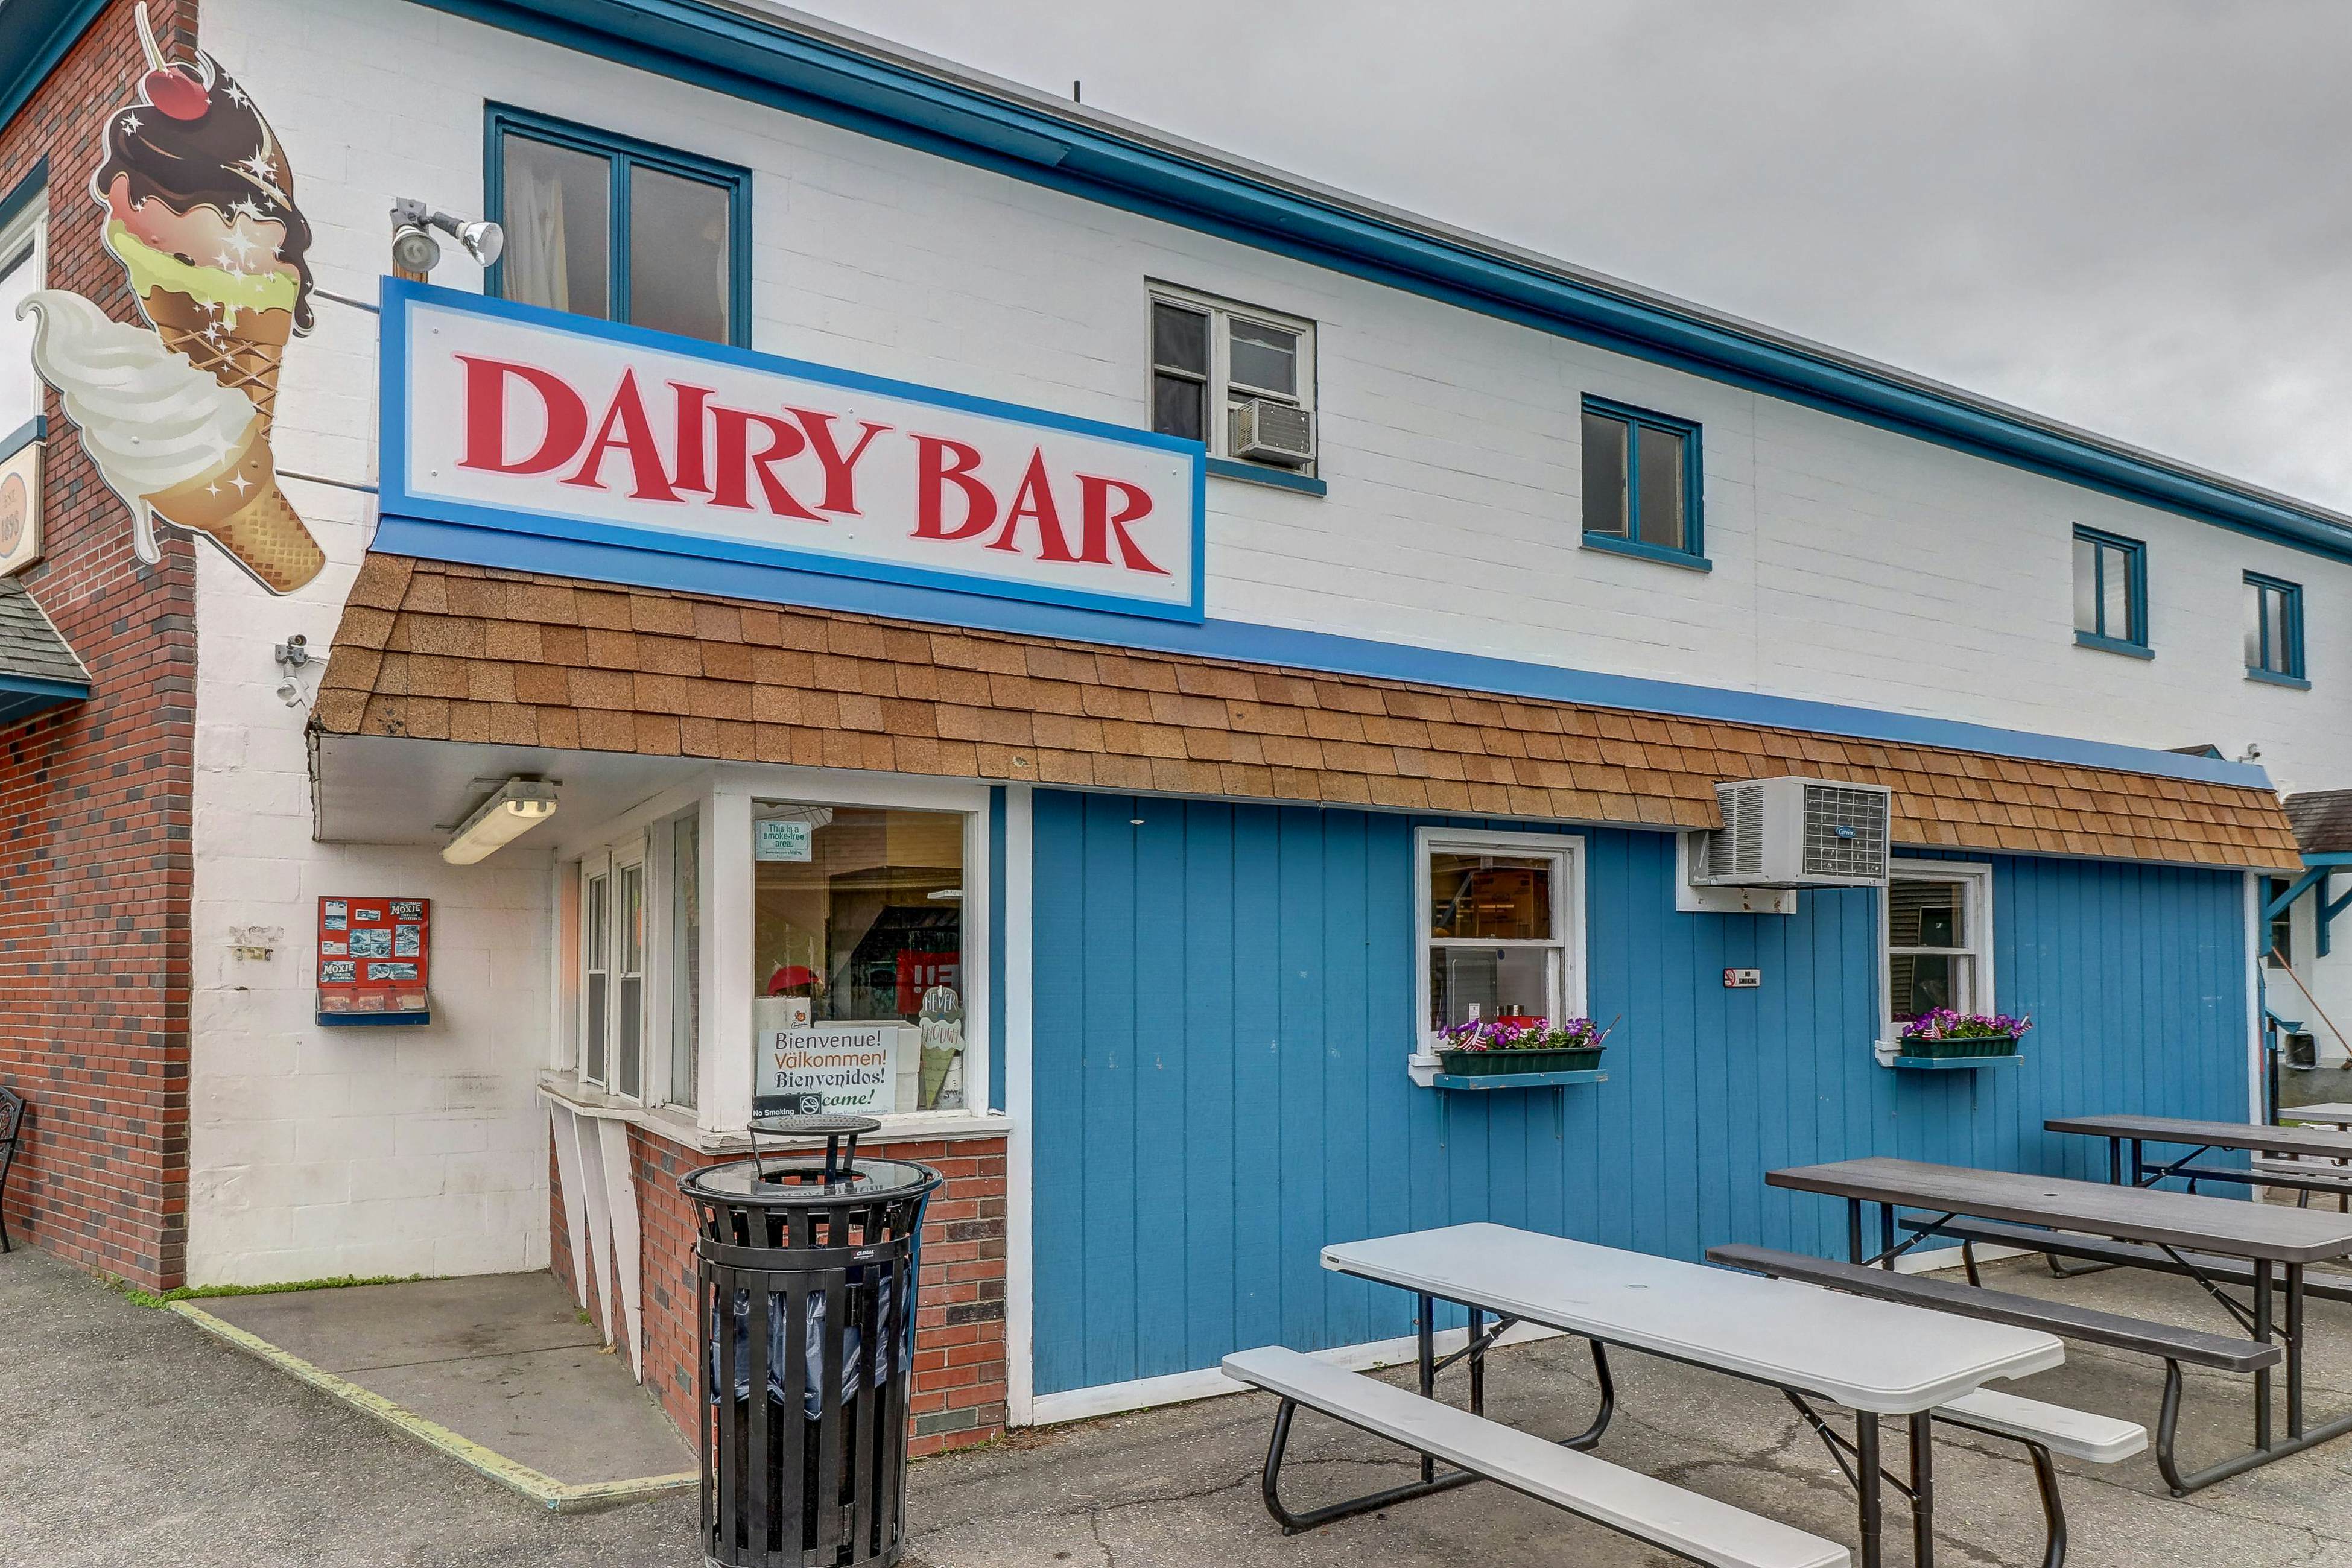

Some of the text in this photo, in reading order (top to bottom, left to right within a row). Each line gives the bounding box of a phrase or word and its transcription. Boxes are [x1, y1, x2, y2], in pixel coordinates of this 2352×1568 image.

[454, 353, 1171, 575] DAIRY BAR
[390, 905, 420, 915] MOXIE
[323, 964, 354, 975] MOXIE
[925, 991, 957, 1013] NEVER
[775, 1030, 881, 1049] Bienvenue!
[775, 1049, 886, 1069] Välkommen!
[775, 1067, 885, 1089] Bienvenidos!
[786, 1089, 875, 1107] come!
